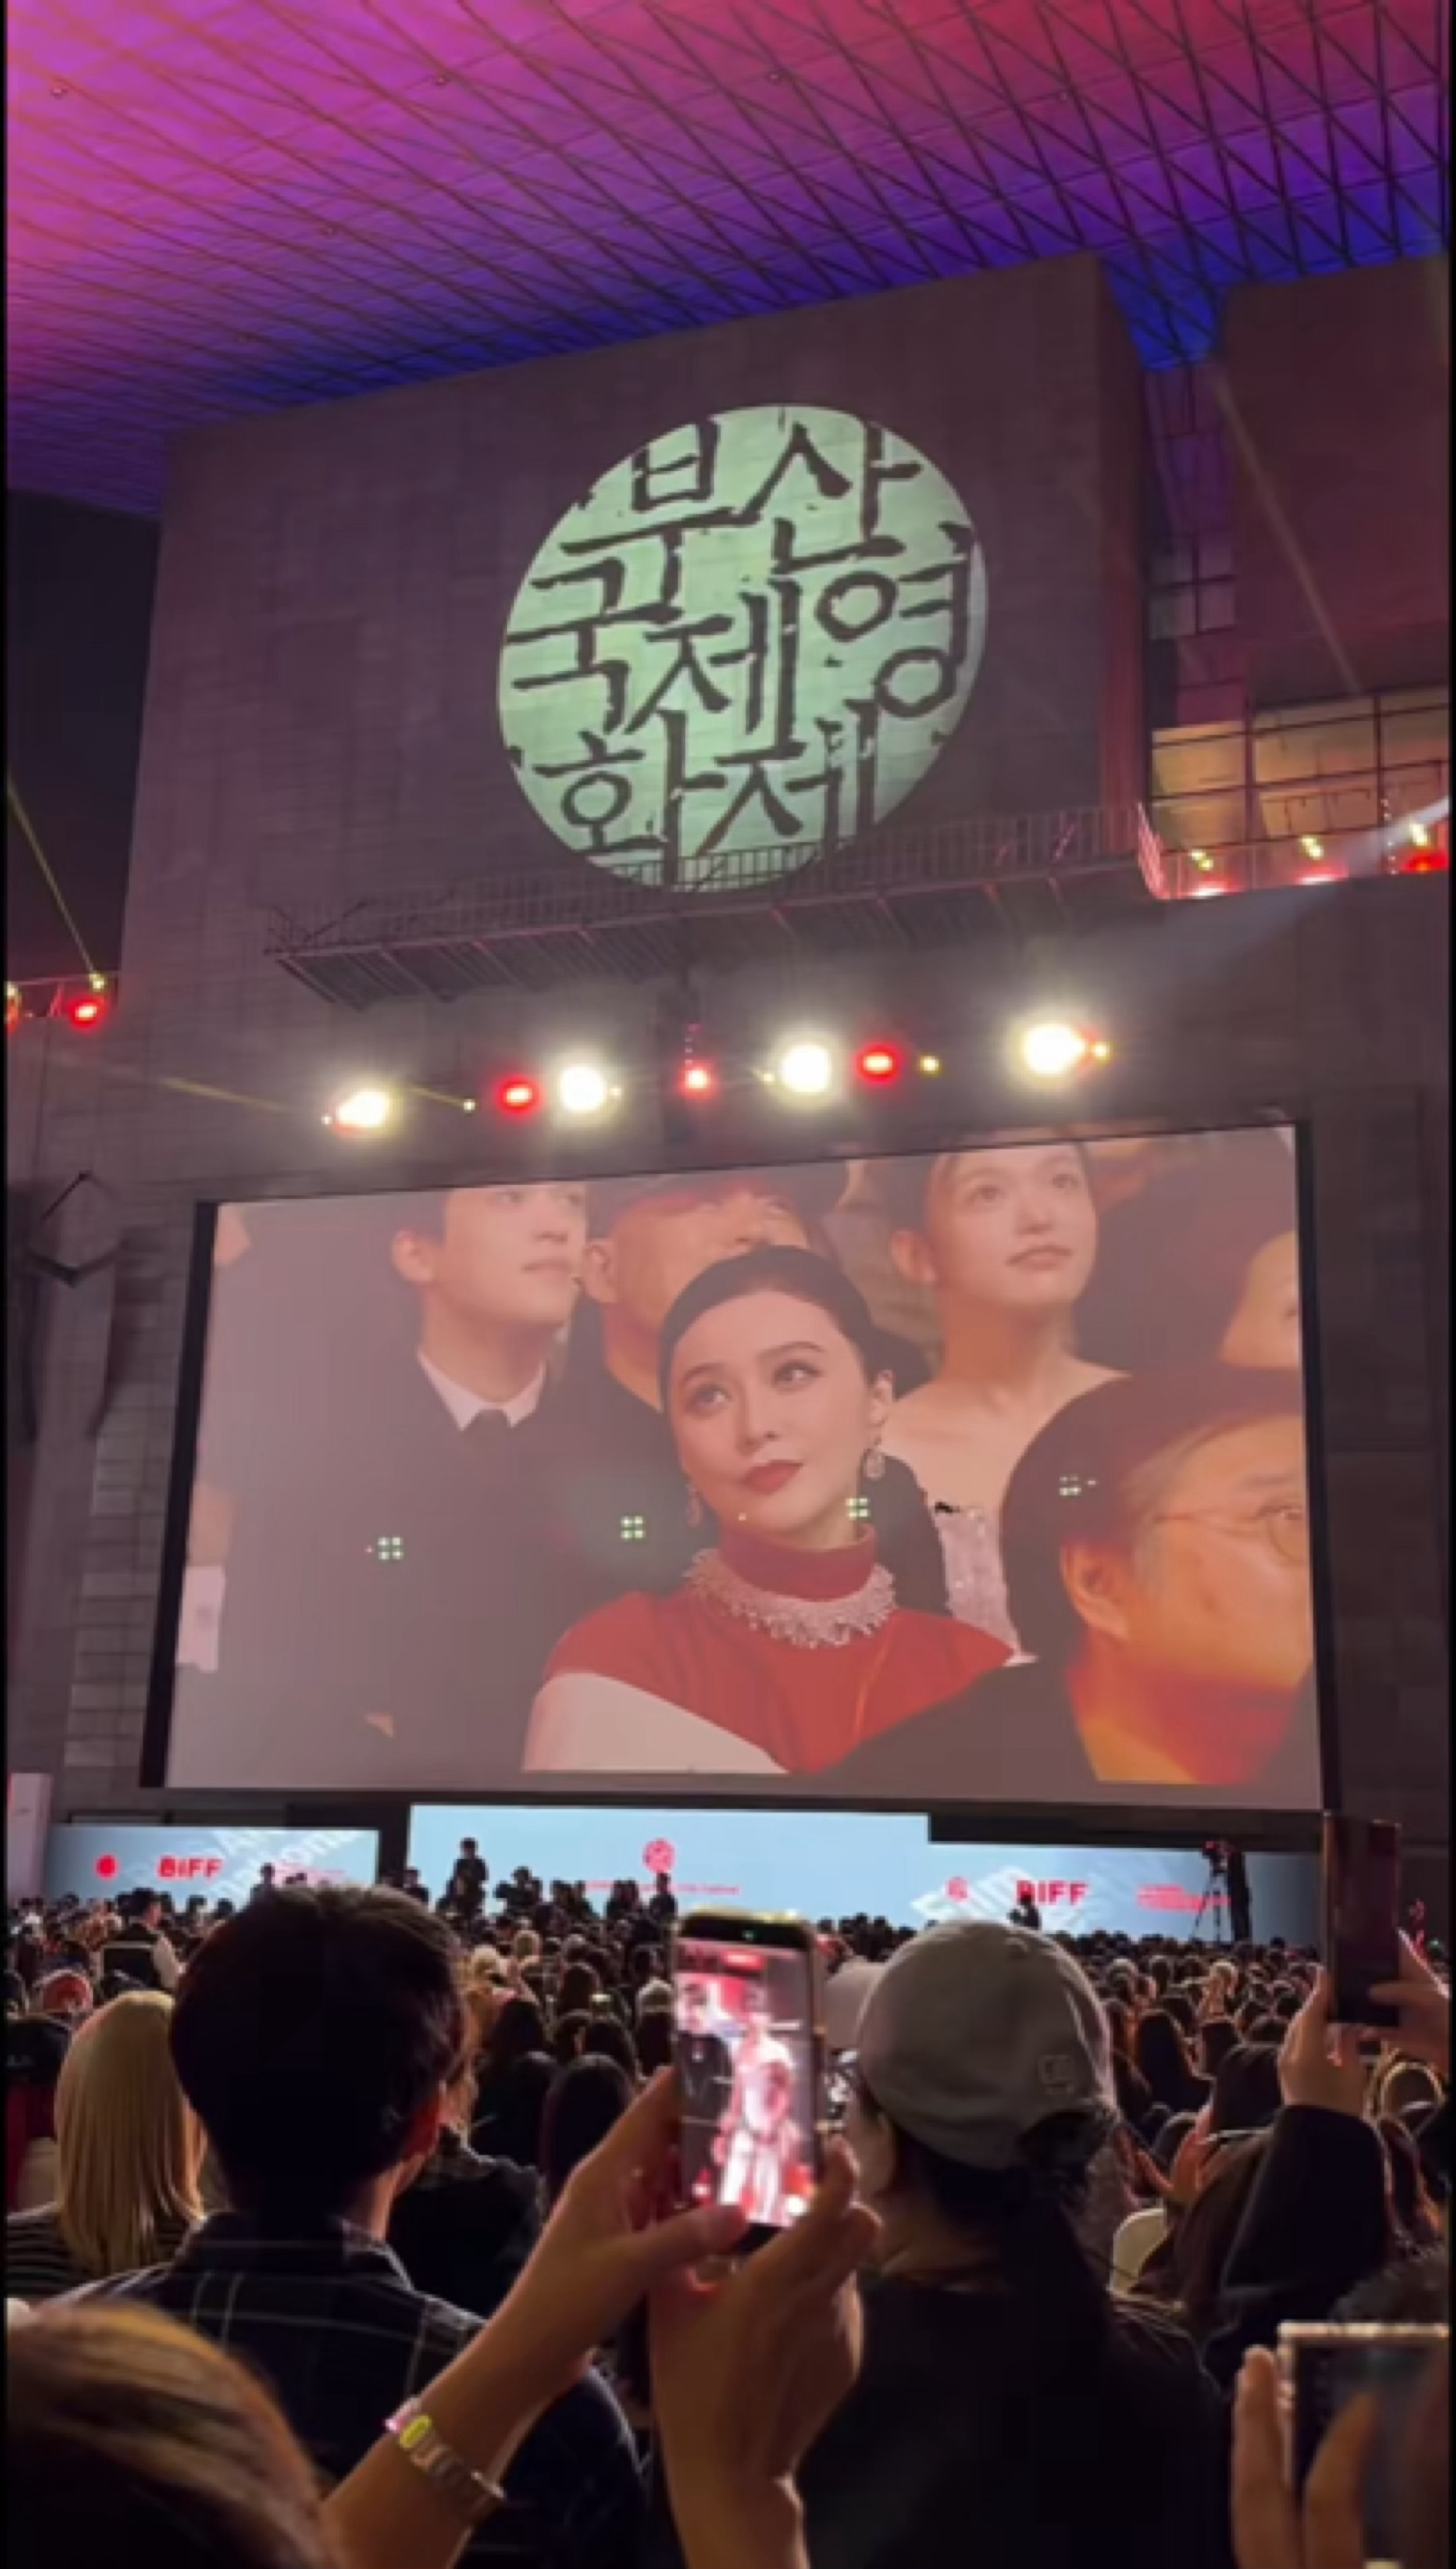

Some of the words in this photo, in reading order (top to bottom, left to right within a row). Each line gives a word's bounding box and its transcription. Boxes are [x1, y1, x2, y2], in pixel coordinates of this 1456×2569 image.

[559, 419, 923, 608] 부산
[504, 523, 976, 750] 국제영
[535, 699, 878, 891] 화제
